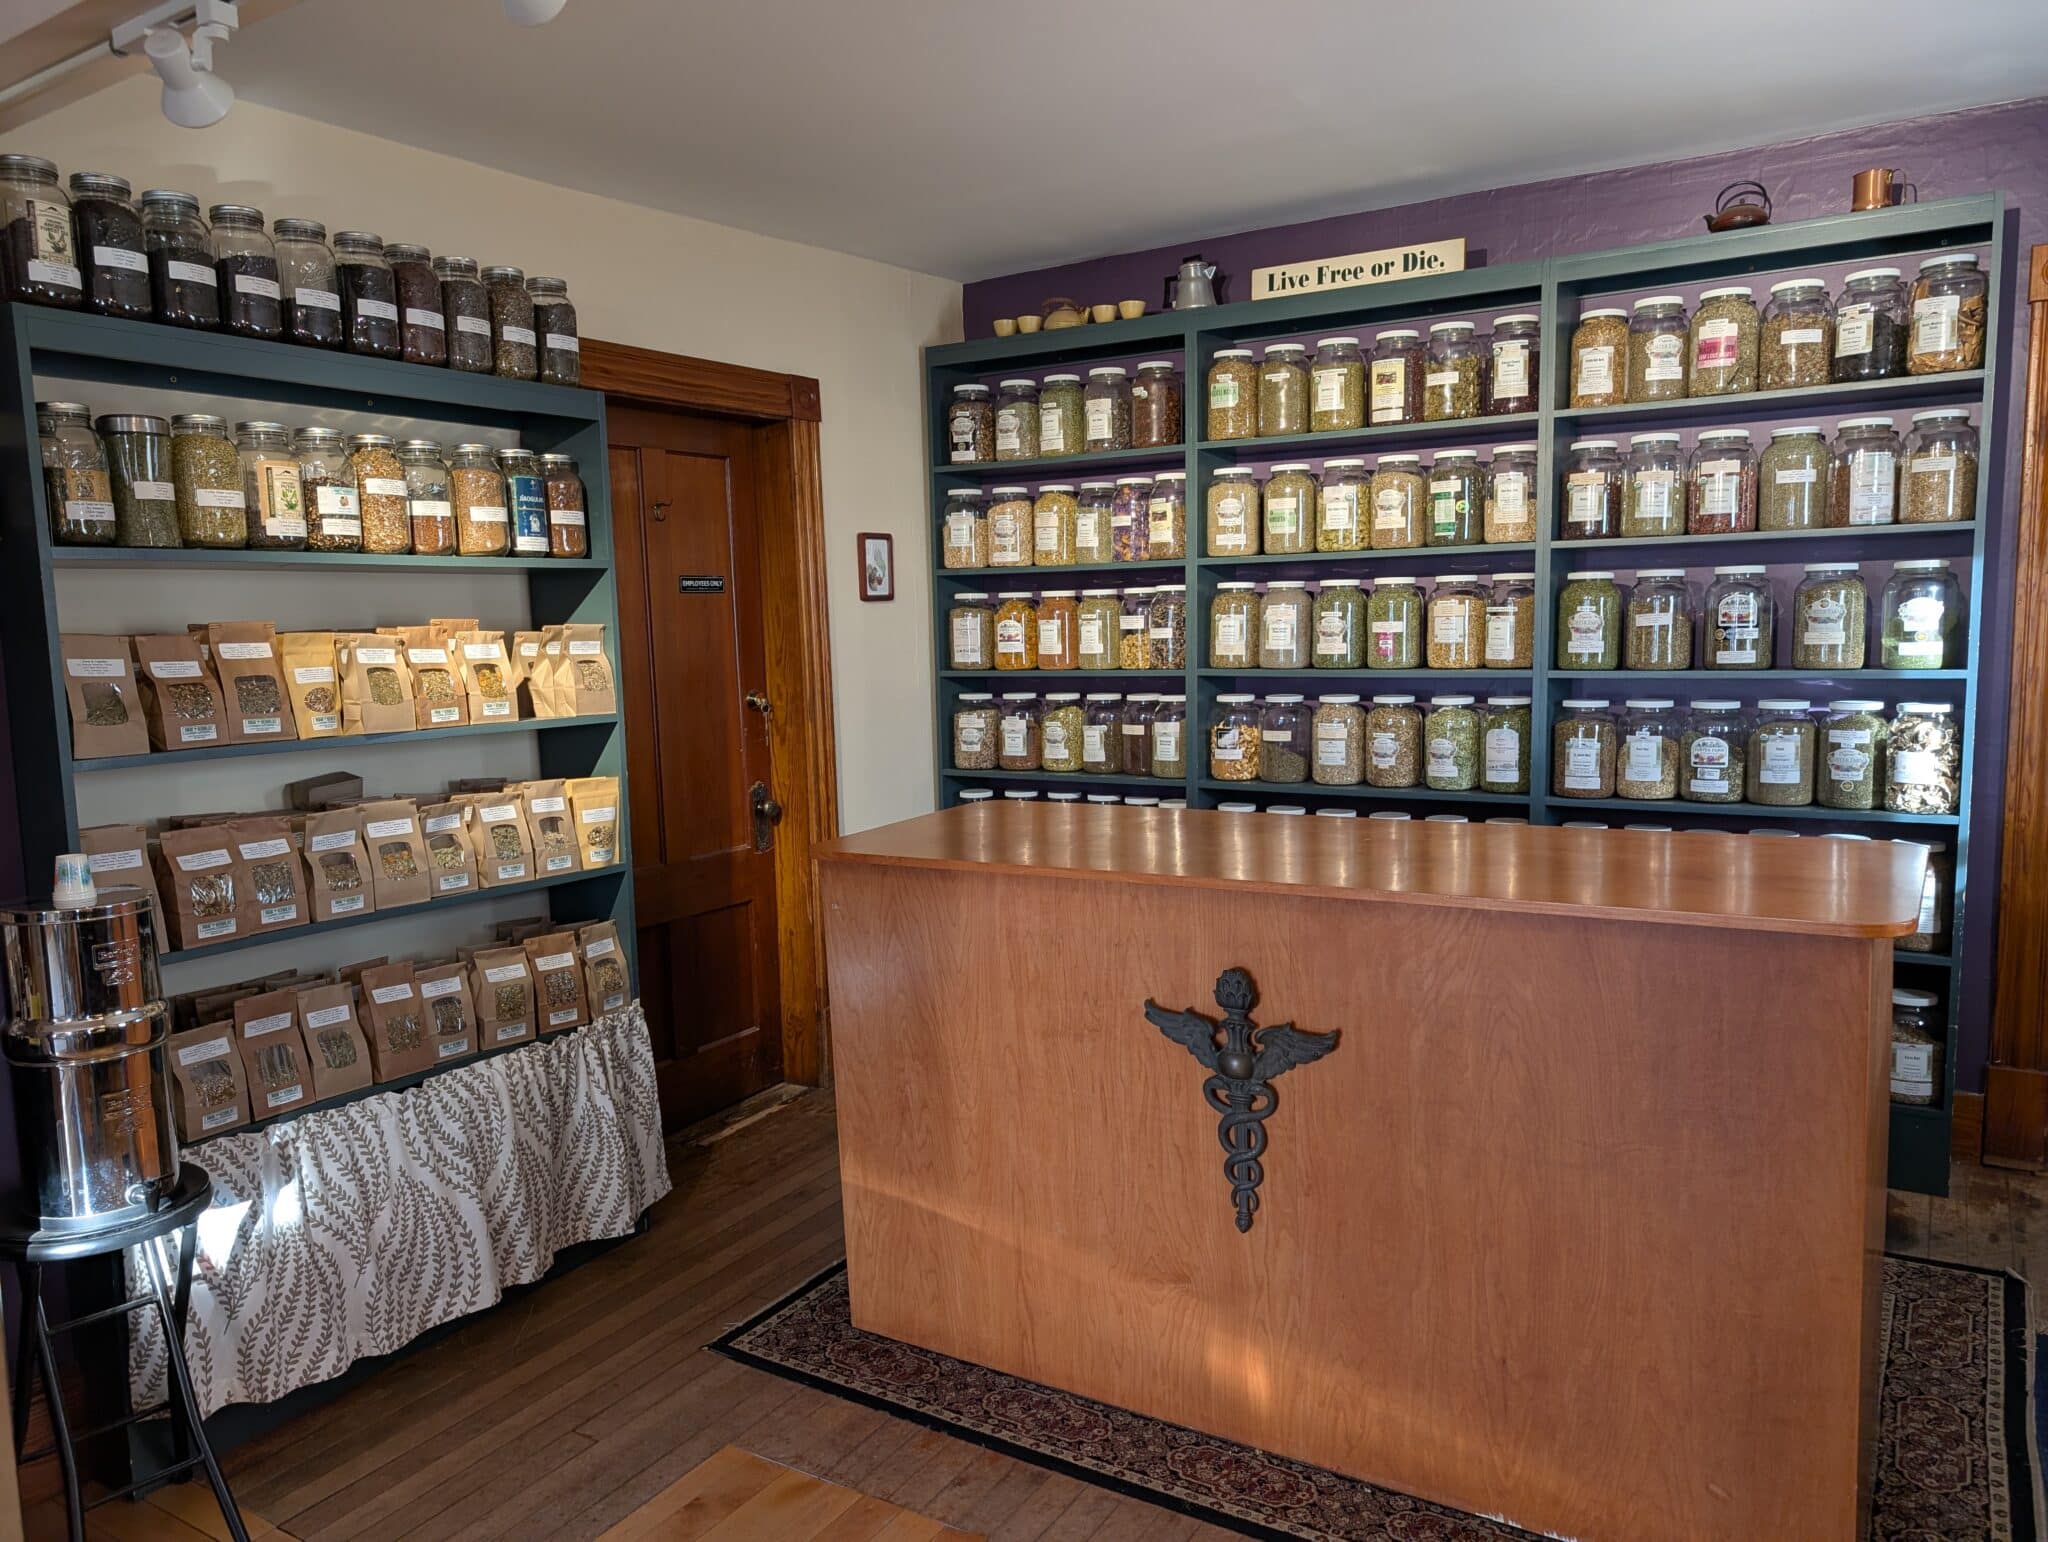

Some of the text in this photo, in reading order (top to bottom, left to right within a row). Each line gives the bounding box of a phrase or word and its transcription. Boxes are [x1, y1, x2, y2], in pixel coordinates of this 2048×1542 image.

[1267, 250, 1445, 293] Live Free or Die.
